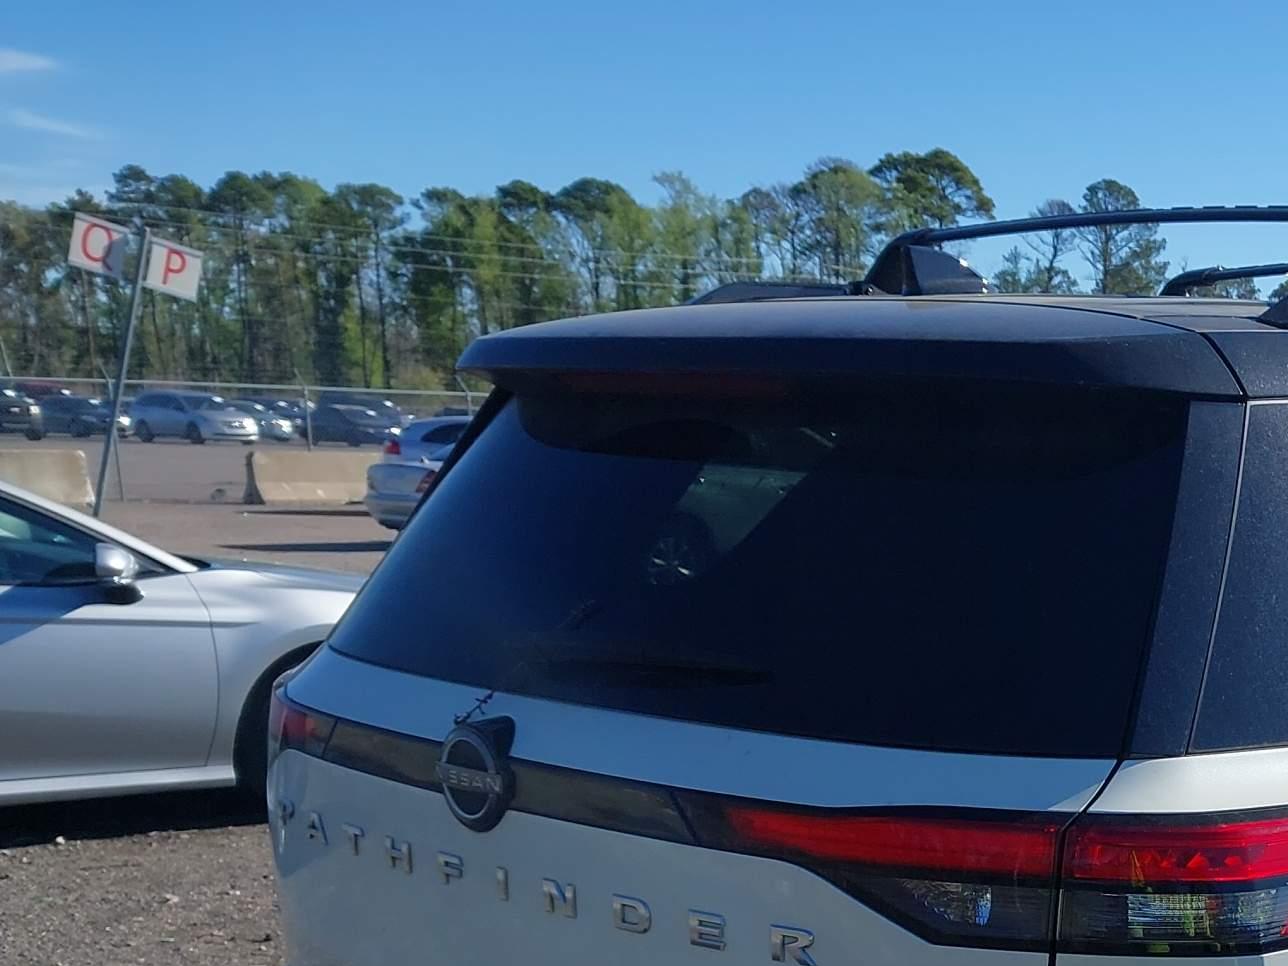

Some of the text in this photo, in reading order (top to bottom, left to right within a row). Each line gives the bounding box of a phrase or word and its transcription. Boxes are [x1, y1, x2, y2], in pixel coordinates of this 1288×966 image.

[81, 222, 113, 272] Q
[162, 247, 188, 286] P
[435, 763, 502, 794] NSSAN
